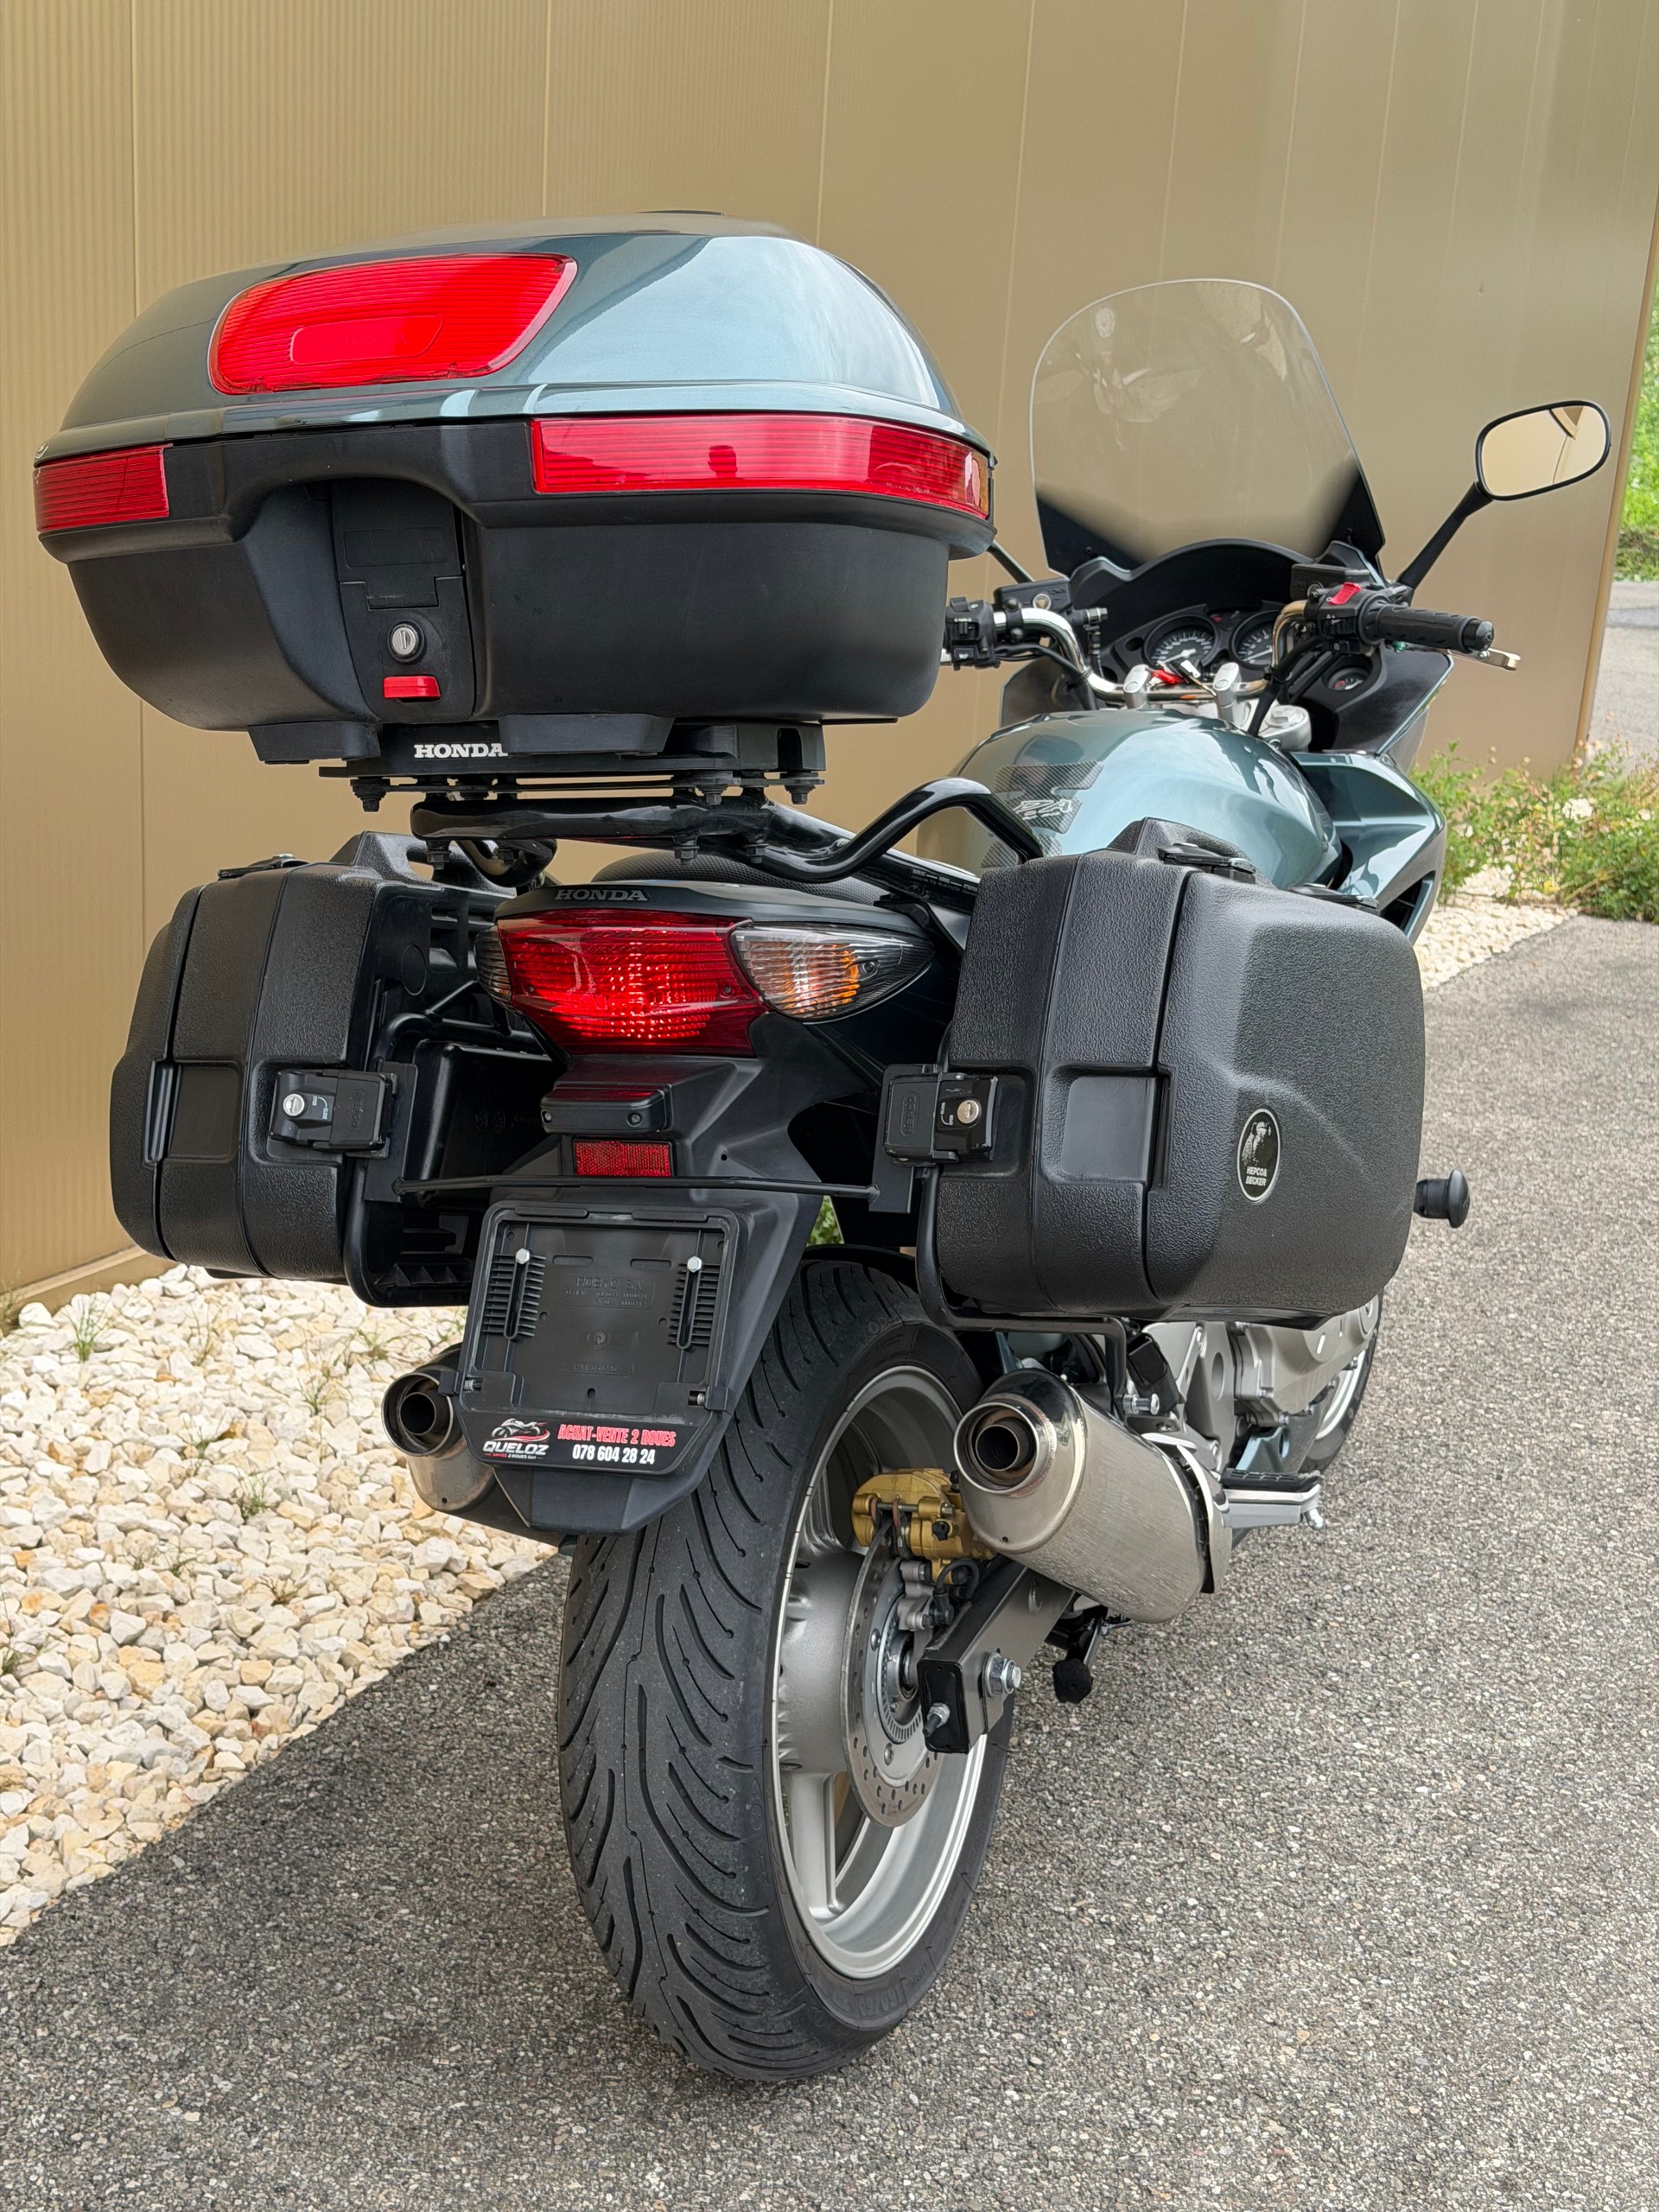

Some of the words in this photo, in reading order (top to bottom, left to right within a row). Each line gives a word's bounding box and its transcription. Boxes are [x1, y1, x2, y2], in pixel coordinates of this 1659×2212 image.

[414, 743, 508, 758] HONDA
[554, 889, 647, 901] HONDA
[1245, 1176, 1267, 1186] BECKER
[557, 1424, 629, 1444] ACHAT-VENTE
[630, 1428, 639, 1444] 2
[640, 1429, 677, 1447] ROUES
[482, 1440, 550, 1456] QUELOZ
[572, 1444, 595, 1460] 078
[597, 1446, 620, 1462] 604
[621, 1447, 638, 1463] 28
[639, 1448, 656, 1465] 24
